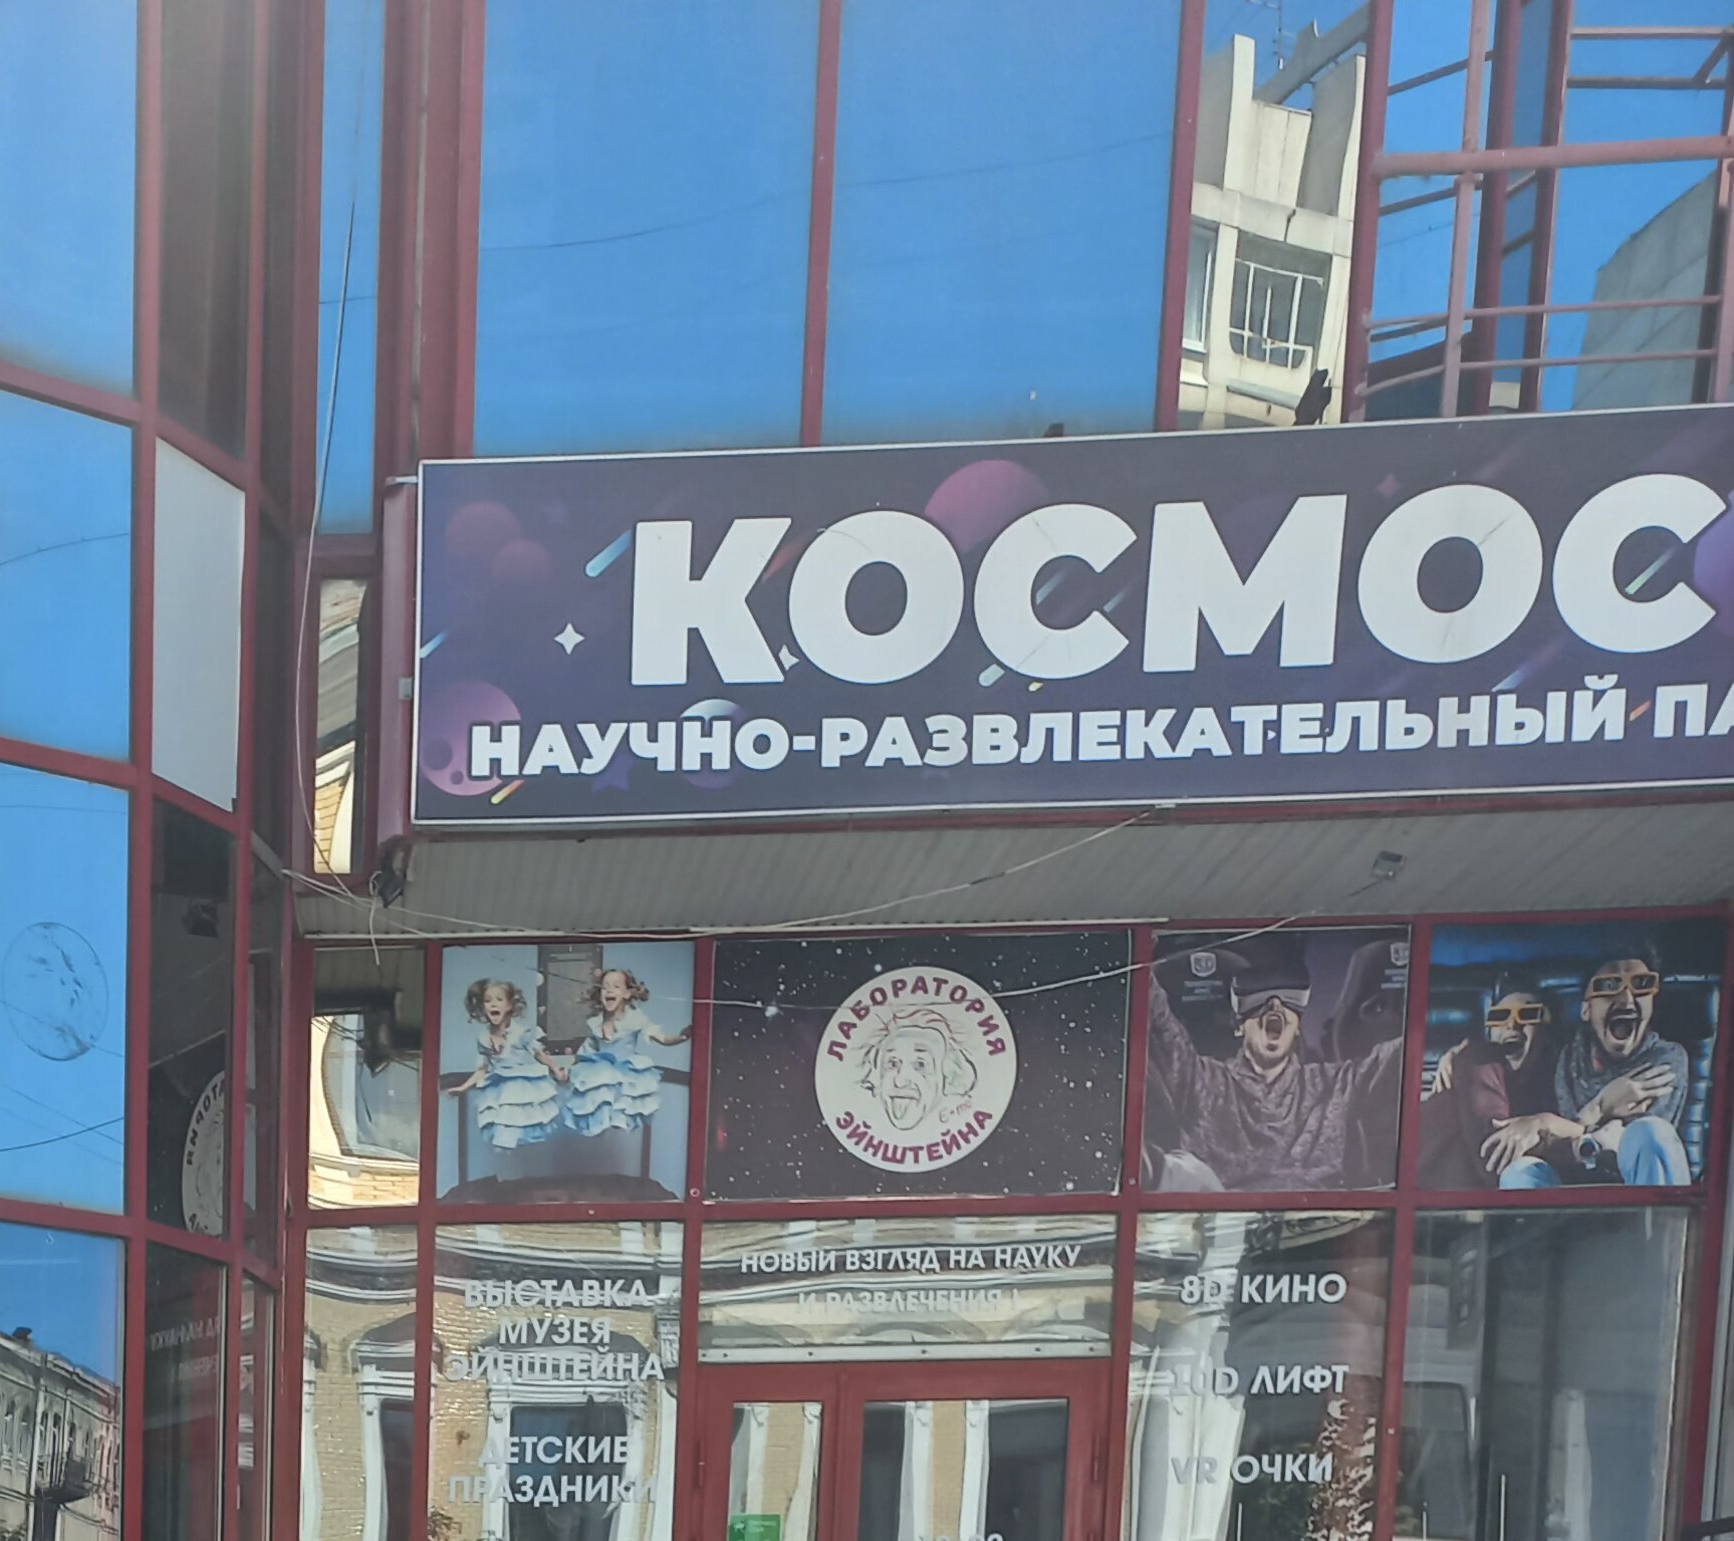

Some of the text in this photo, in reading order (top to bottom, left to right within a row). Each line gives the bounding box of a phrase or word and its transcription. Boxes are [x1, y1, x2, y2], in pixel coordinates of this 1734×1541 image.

[629, 474, 1727, 685] КОСМОС
[470, 674, 1627, 777] НАУЧНО-РАЗВЛЕКАТЕЛЬНЫЙ
[827, 976, 1006, 1061] ЛАБОРАТОРИЯ
[836, 1110, 993, 1164] ЭЙНШТЕЙНА
[740, 1245, 1082, 1274] НОВЫЙ ВЗГЛЯД НА НАУКУ
[464, 1279, 651, 1308] ВЫСТАВКА
[825, 1288, 1002, 1314] РАЗВЛЕЧЕНИЯ
[1180, 1273, 1348, 1304] 8D КИНО
[498, 1316, 611, 1344] МУЗЕЯ
[443, 1345, 665, 1382] ЭЙНШТЕЙНА
[1250, 1365, 1350, 1395] ЛИФТ
[479, 1435, 632, 1469] ДЕТСКИЕ
[1171, 1453, 1334, 1485] VR ОЧКИ
[448, 1474, 656, 1508] ПРАЗДНИКИ
